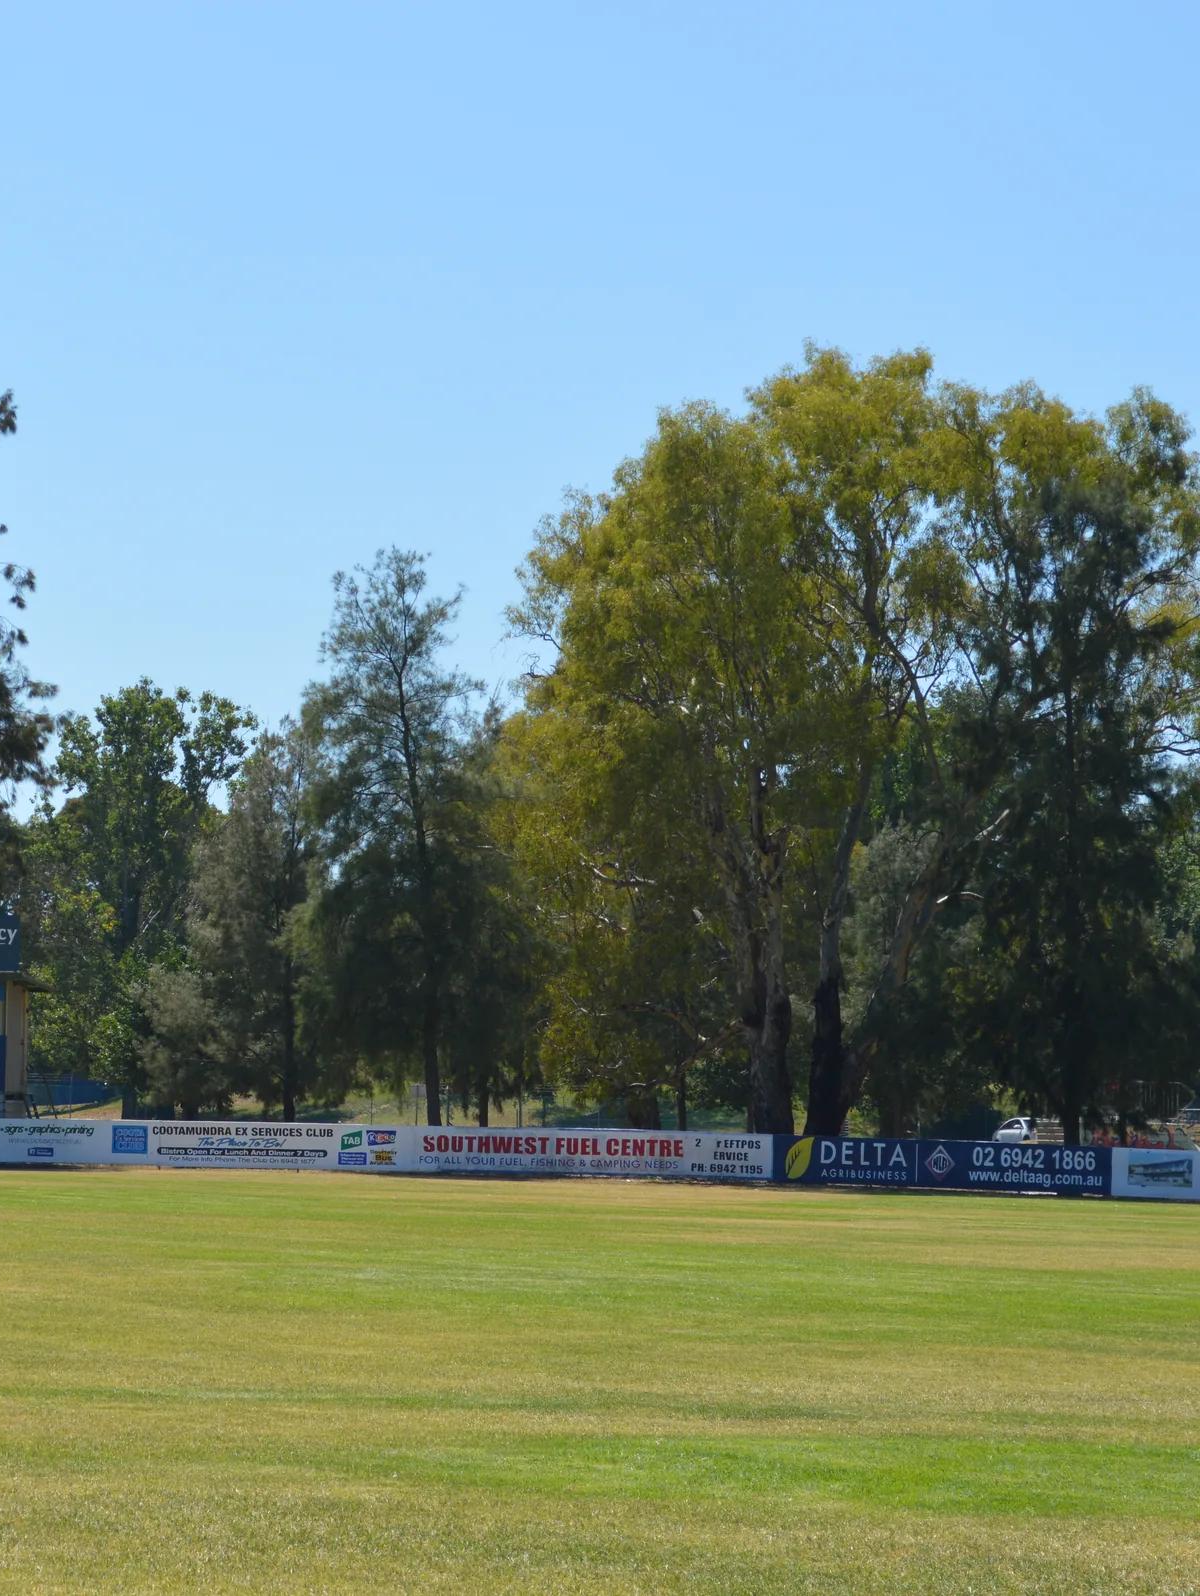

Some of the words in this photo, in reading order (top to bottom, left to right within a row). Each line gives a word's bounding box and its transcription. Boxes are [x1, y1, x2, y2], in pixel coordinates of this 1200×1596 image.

[152, 1126, 231, 1136] COOTAMUNDRA
[235, 1127, 248, 1136] EX
[251, 1127, 303, 1137] SERVICES
[306, 1128, 334, 1137] CLUB
[342, 1136, 361, 1145] TAB
[423, 1135, 550, 1155] SOUTHWEST
[555, 1137, 601, 1156] FUEL
[606, 1137, 684, 1158] CENTRE
[724, 1140, 761, 1149] EFTPOS
[304, 1150, 324, 1158] Days
[820, 1140, 907, 1167] DELTA
[972, 1147, 995, 1167] 02
[1000, 1148, 1045, 1169] 6942
[1052, 1149, 1096, 1171] 1866
[419, 1156, 440, 1165] FOR
[444, 1156, 462, 1165] ALL
[465, 1157, 495, 1166] YOUR
[530, 1158, 575, 1168] FISHING
[590, 1159, 640, 1169] CAMPING
[644, 1160, 679, 1169] NEEDS
[691, 1163, 707, 1173] PH:
[710, 1163, 736, 1173] 6942
[740, 1165, 763, 1174] 1195
[821, 1168, 907, 1181] AGRIBUSINESS
[968, 1169, 1103, 1187] www.deltaag.com.au
